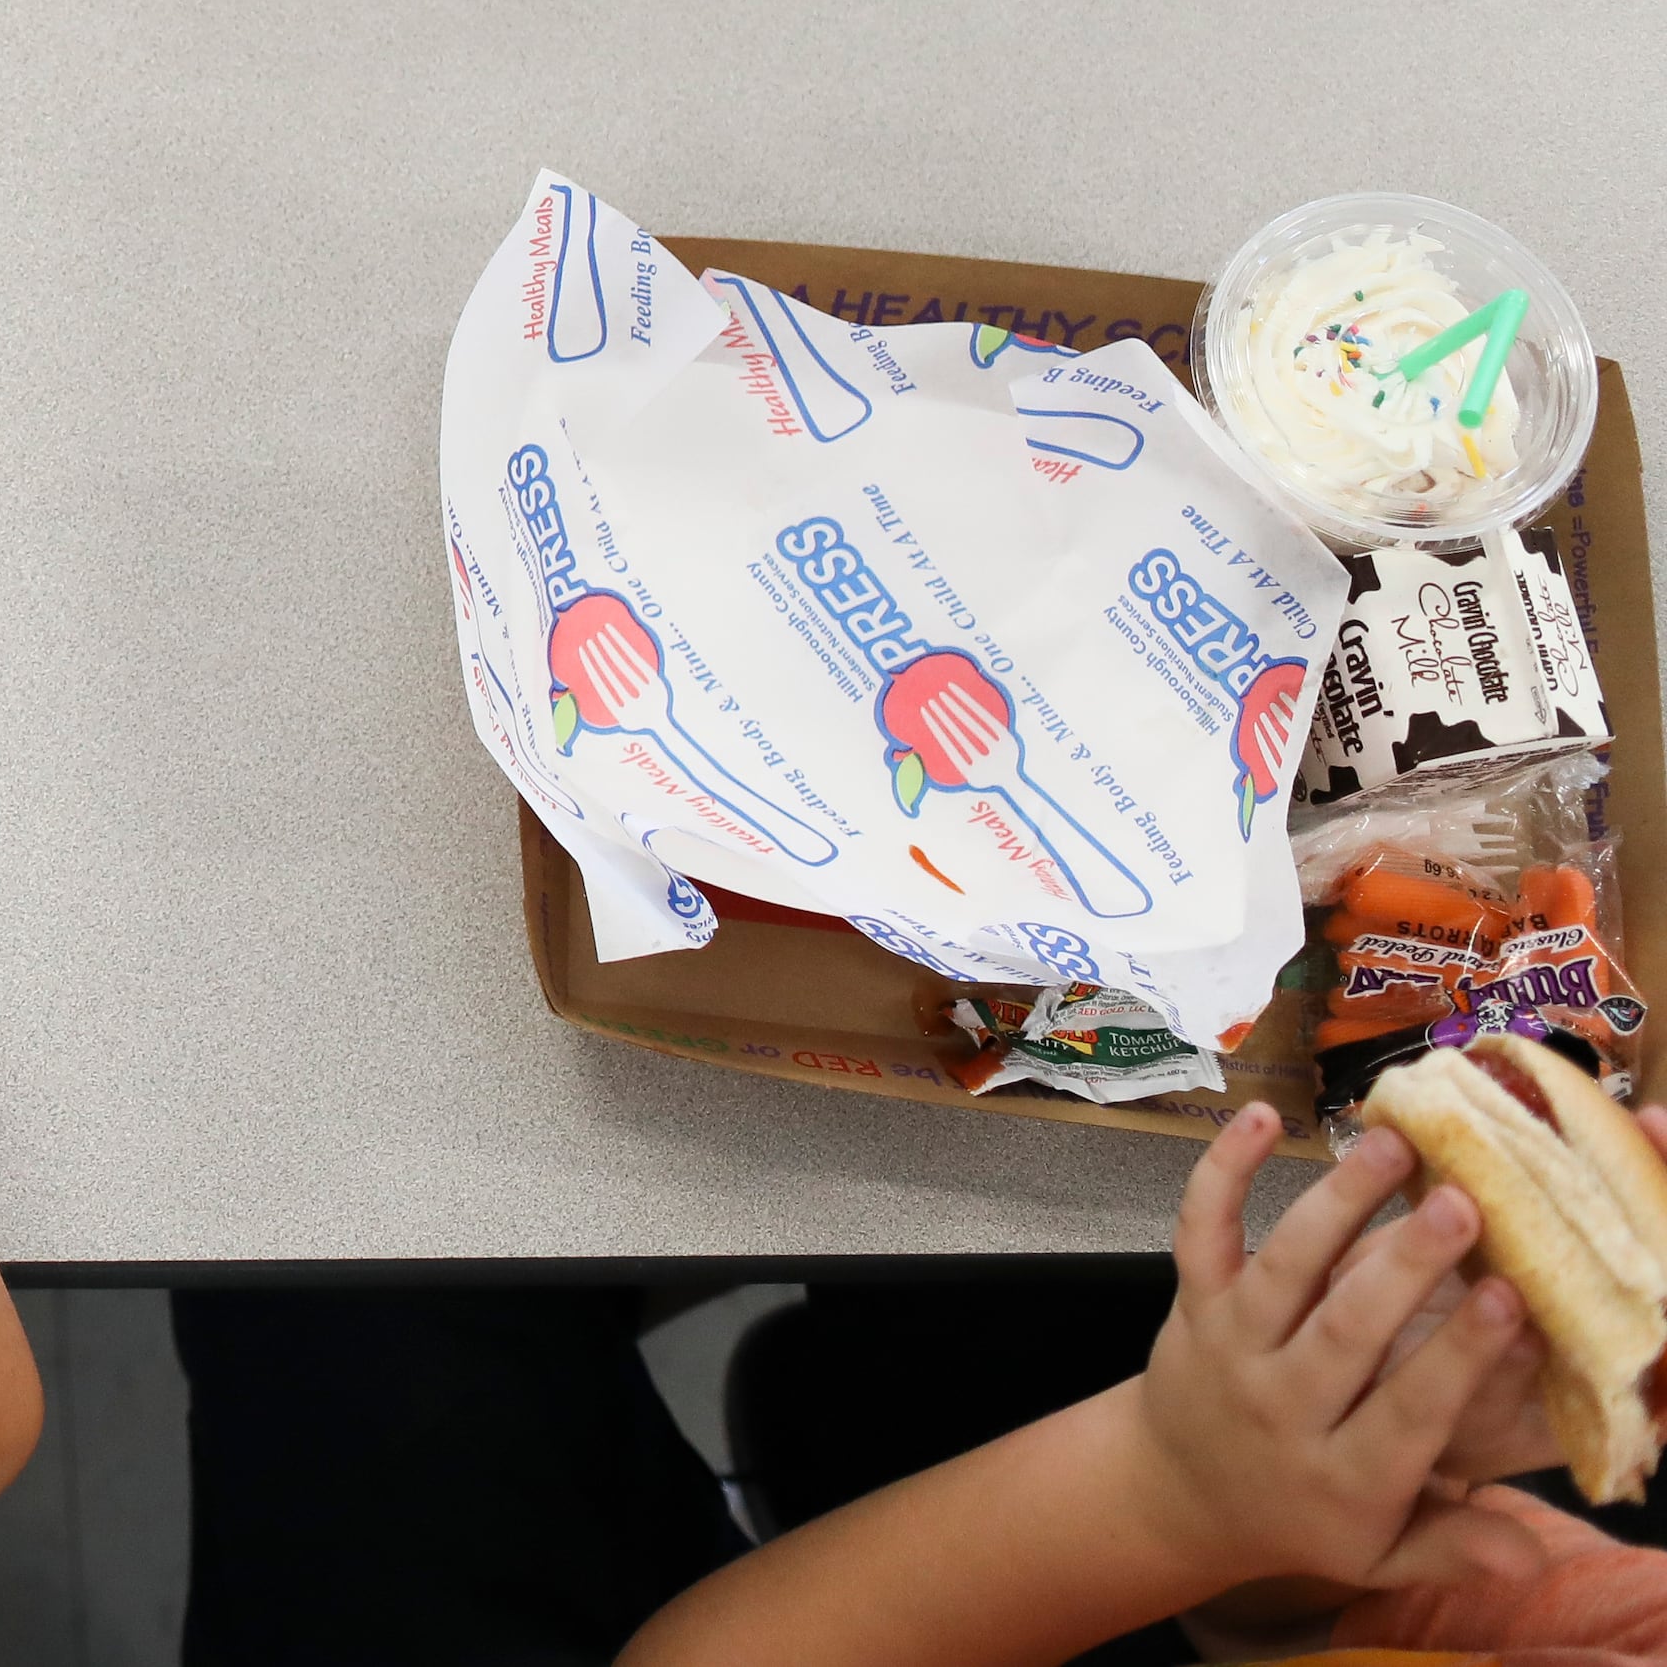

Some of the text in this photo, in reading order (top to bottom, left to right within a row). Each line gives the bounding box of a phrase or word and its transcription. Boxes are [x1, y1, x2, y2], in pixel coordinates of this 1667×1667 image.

[522, 196, 558, 340] Healthy Meals
[630, 260, 658, 348] Feeding
[738, 352, 804, 437] Healthy
[866, 339, 918, 396] Feeding
[1069, 365, 1167, 417] Feeding
[507, 442, 586, 611] PRESS
[861, 482, 977, 633] Child At Time
[1179, 503, 1320, 641] Child At Time
[627, 577, 664, 620] One
[746, 560, 864, 704] Hillsborough County
[776, 514, 926, 673] PRESS
[1127, 547, 1269, 699] PRESS
[1418, 581, 1471, 707] Chocolate
[1453, 580, 1511, 707] Cravin' Chocolate
[1102, 605, 1221, 737] Hillsborough County
[1116, 594, 1236, 725] Student Services
[1338, 617, 1395, 720] Cravin'
[1390, 614, 1441, 690] Milk
[620, 741, 688, 798] Meals
[666, 620, 864, 841] Feeding Body & Mind...
[974, 631, 1195, 888] Feeding Body & Mind... One
[966, 799, 1033, 863] Meals
[1355, 934, 1441, 963] Peeled
[1504, 925, 1584, 959] Classic
[1109, 1031, 1175, 1047] TOMATO
[1109, 1039, 1181, 1058] KETCHUP
